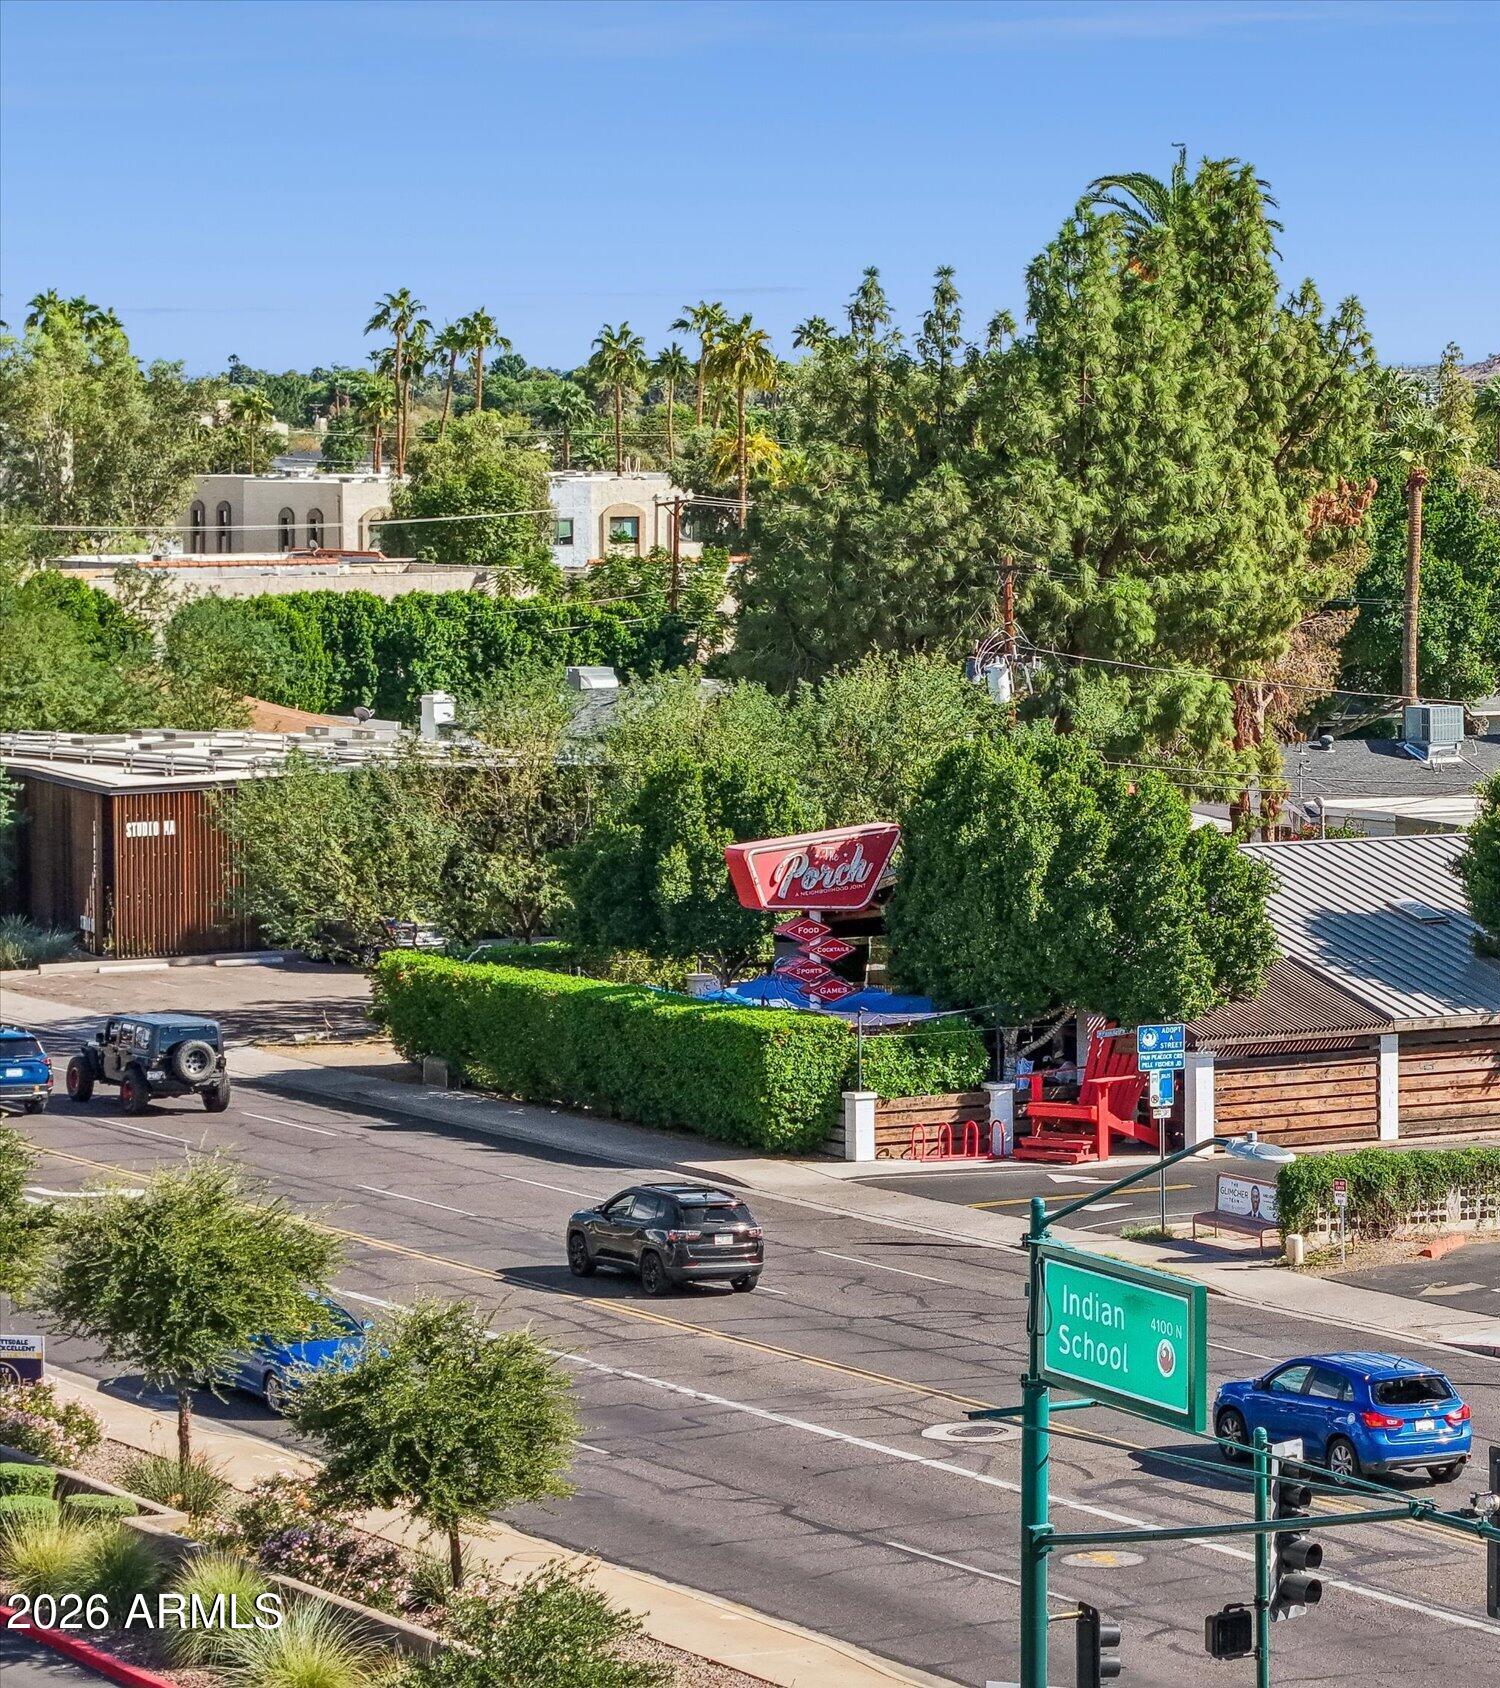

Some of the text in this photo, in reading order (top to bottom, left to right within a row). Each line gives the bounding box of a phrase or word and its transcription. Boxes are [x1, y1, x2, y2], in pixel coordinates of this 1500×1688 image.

[126, 820, 176, 838] STUDIO MA
[820, 846, 839, 861] The
[773, 843, 874, 899] Porch
[801, 885, 849, 897] NEIGHBORHOOD
[820, 987, 848, 995] GAMES
[1161, 1026, 1181, 1034] ADOPT
[1160, 1041, 1183, 1049] STREET
[1220, 1186, 1249, 1199] GLIMCHER
[1062, 1284, 1125, 1331] Indian
[1151, 1317, 1183, 1340] 4100 N
[1058, 1324, 1129, 1374] School
